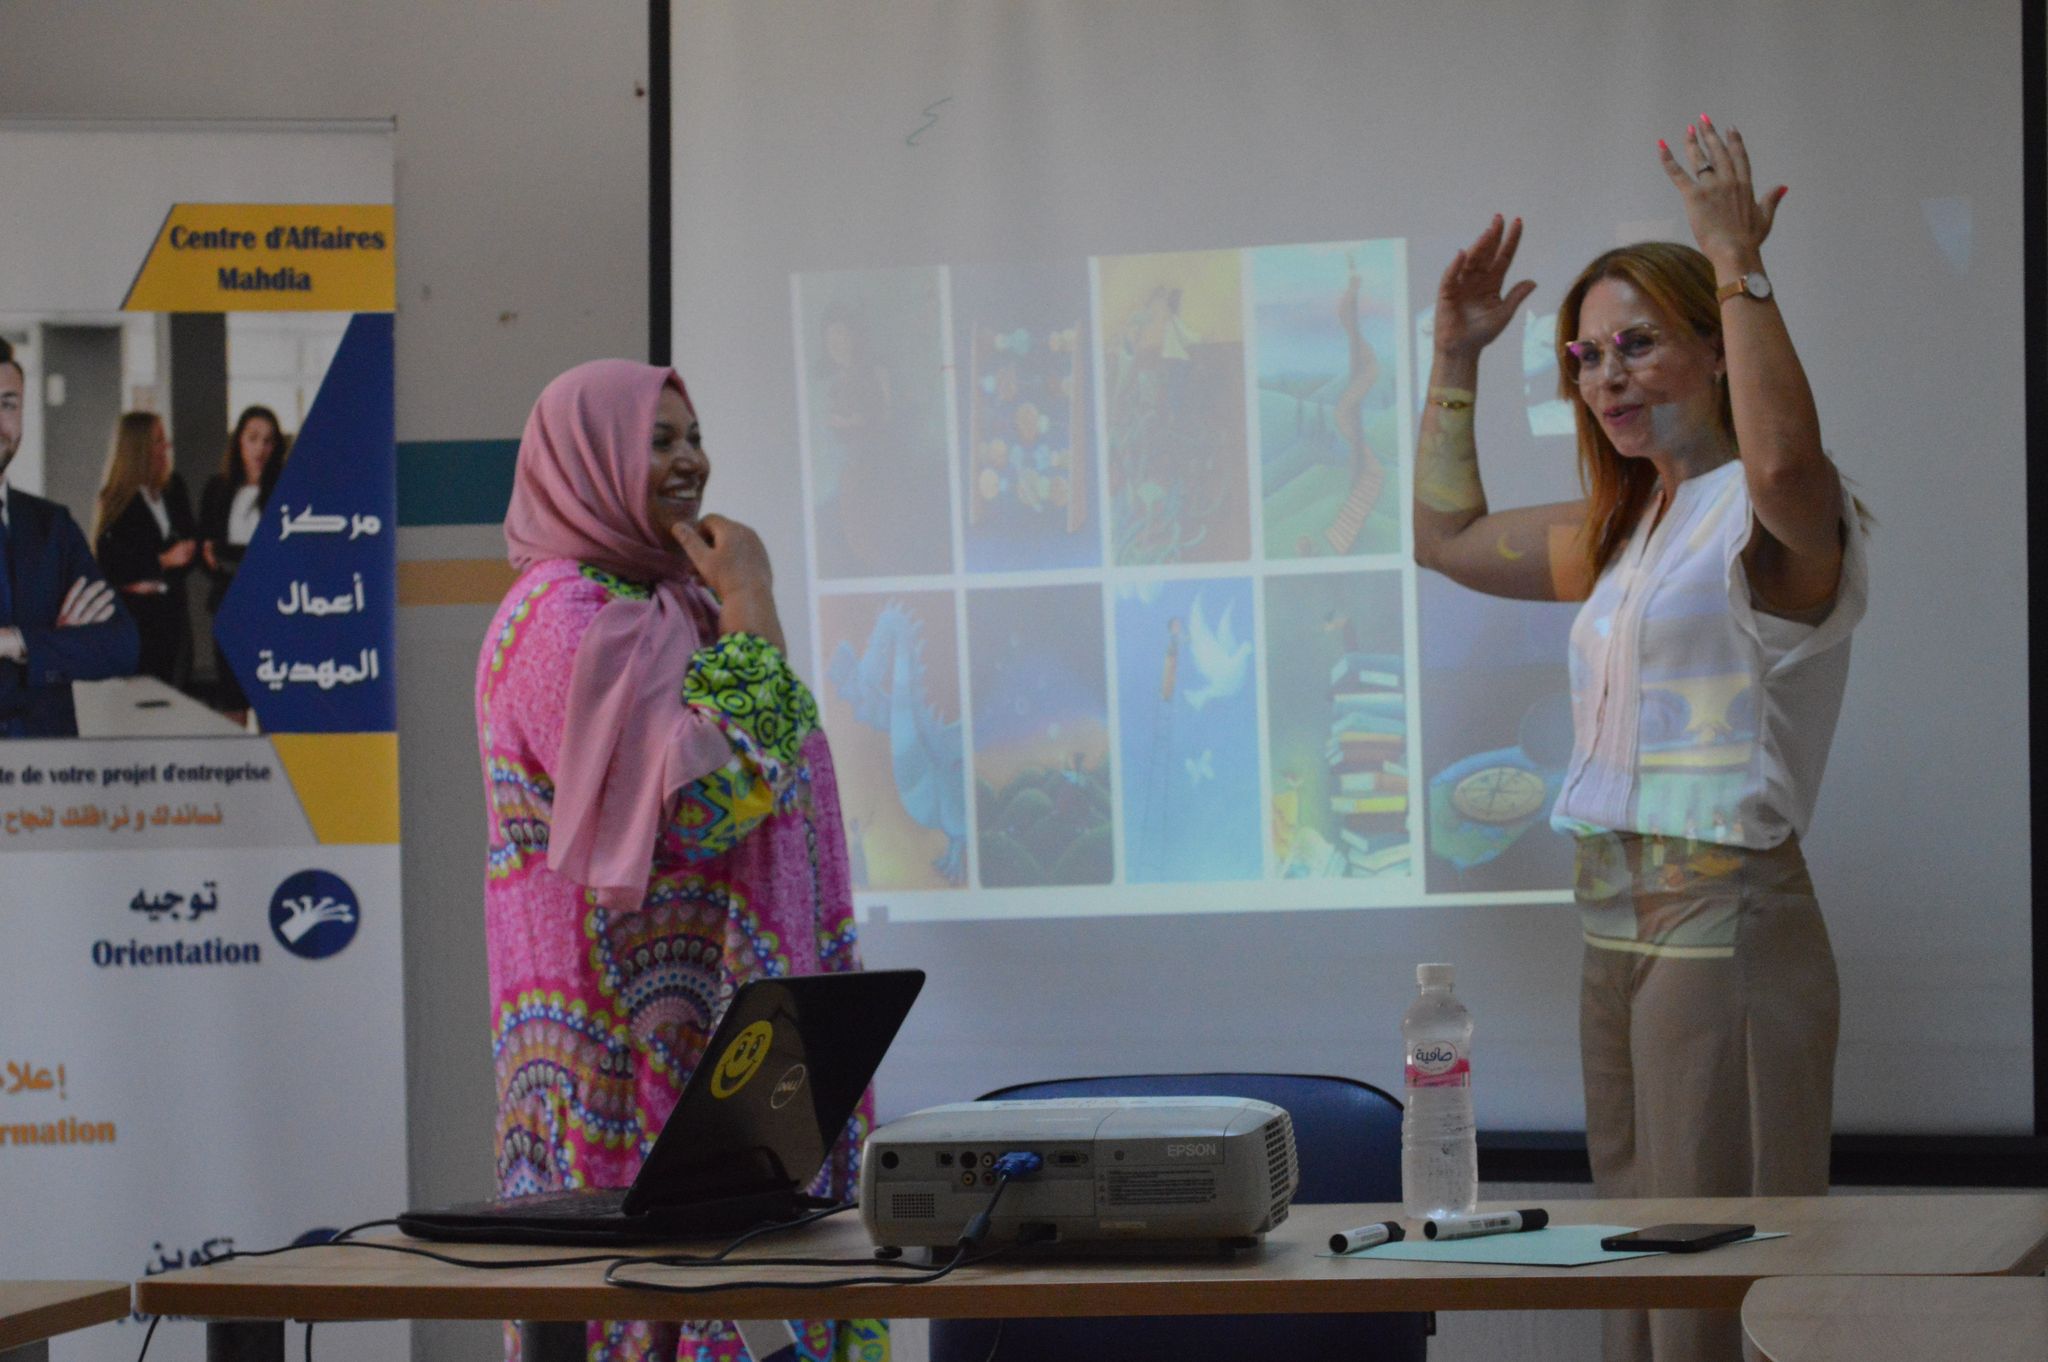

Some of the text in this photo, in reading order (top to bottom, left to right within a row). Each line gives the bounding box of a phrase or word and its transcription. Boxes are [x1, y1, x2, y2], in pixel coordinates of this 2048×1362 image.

[170, 225, 385, 250] Centre d'Affaires
[217, 266, 311, 291] Mahdia
[278, 504, 382, 541] مركز
[276, 571, 365, 616] أعمال
[255, 648, 379, 690] المهدية
[21, 764, 43, 784] de
[49, 765, 96, 784] votre
[102, 764, 156, 787] projet
[162, 762, 271, 787] d'entreprise
[135, 809, 146, 832] و
[129, 880, 218, 921] توجيه
[91, 937, 261, 967] Orientation
[1167, 1143, 1217, 1158] EPSON
